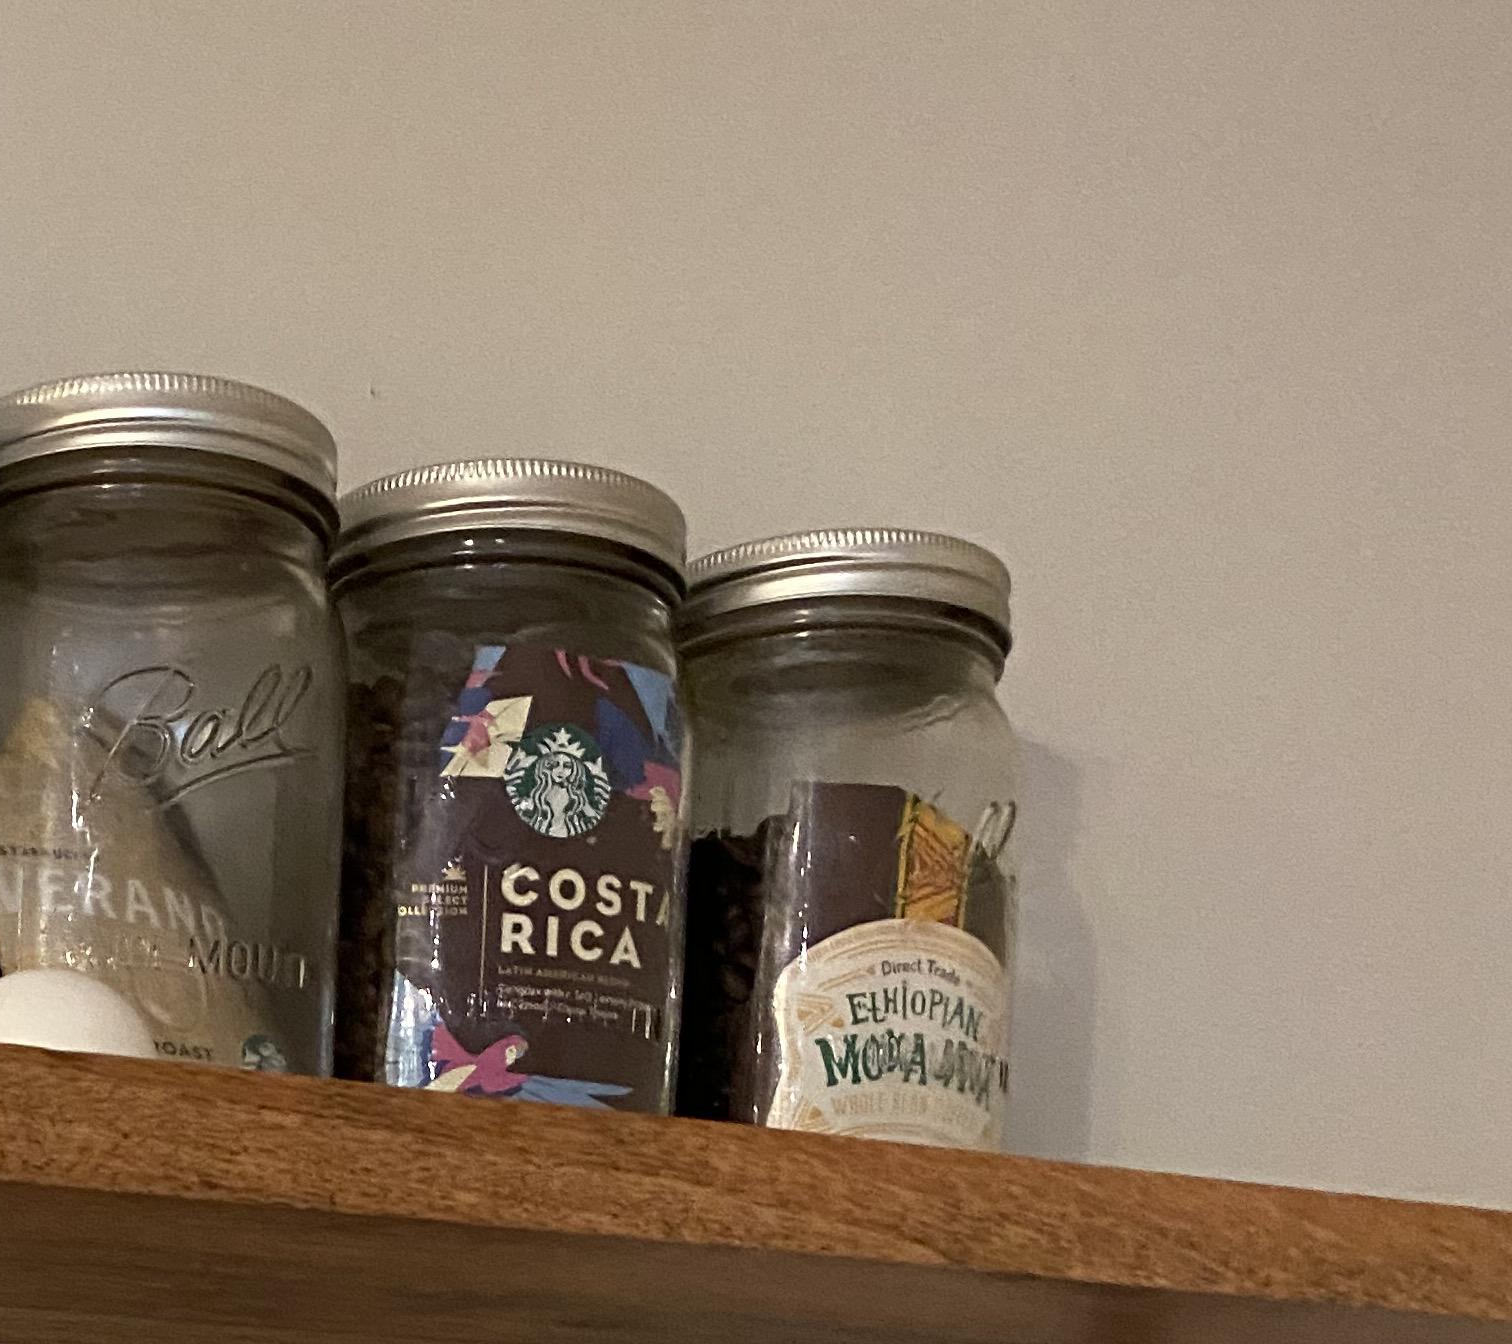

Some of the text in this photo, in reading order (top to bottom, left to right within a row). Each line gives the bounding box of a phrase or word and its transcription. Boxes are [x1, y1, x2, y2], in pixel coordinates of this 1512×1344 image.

[88, 664, 314, 803] Ball
[501, 911, 641, 969] RICA
[881, 959, 922, 976] Direct
